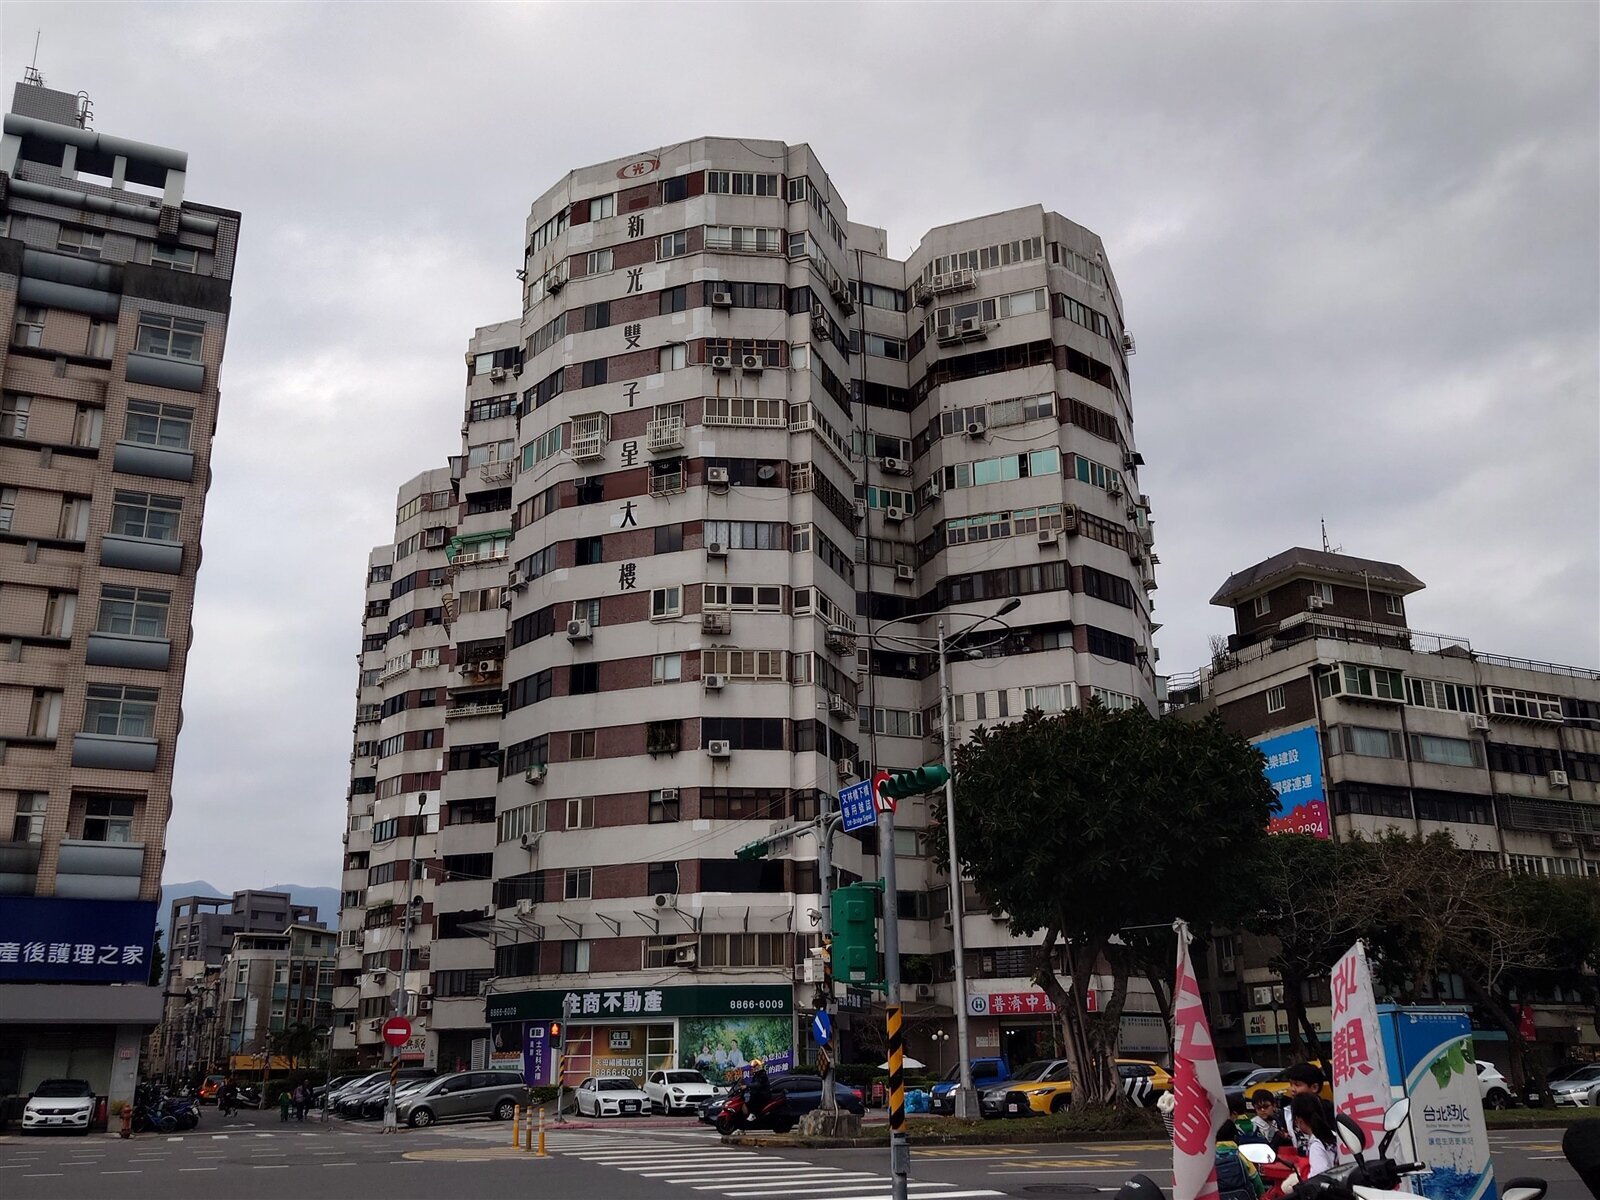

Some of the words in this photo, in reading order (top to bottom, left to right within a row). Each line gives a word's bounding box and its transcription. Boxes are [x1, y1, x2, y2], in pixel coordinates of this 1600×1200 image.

[632, 163, 644, 176] 光
[618, 213, 644, 590] 新光雙子星大樓
[0, 942, 144, 965] 產後護理之家
[563, 990, 662, 1014] 住商不動產
[730, 1000, 784, 1009] 8866-6009
